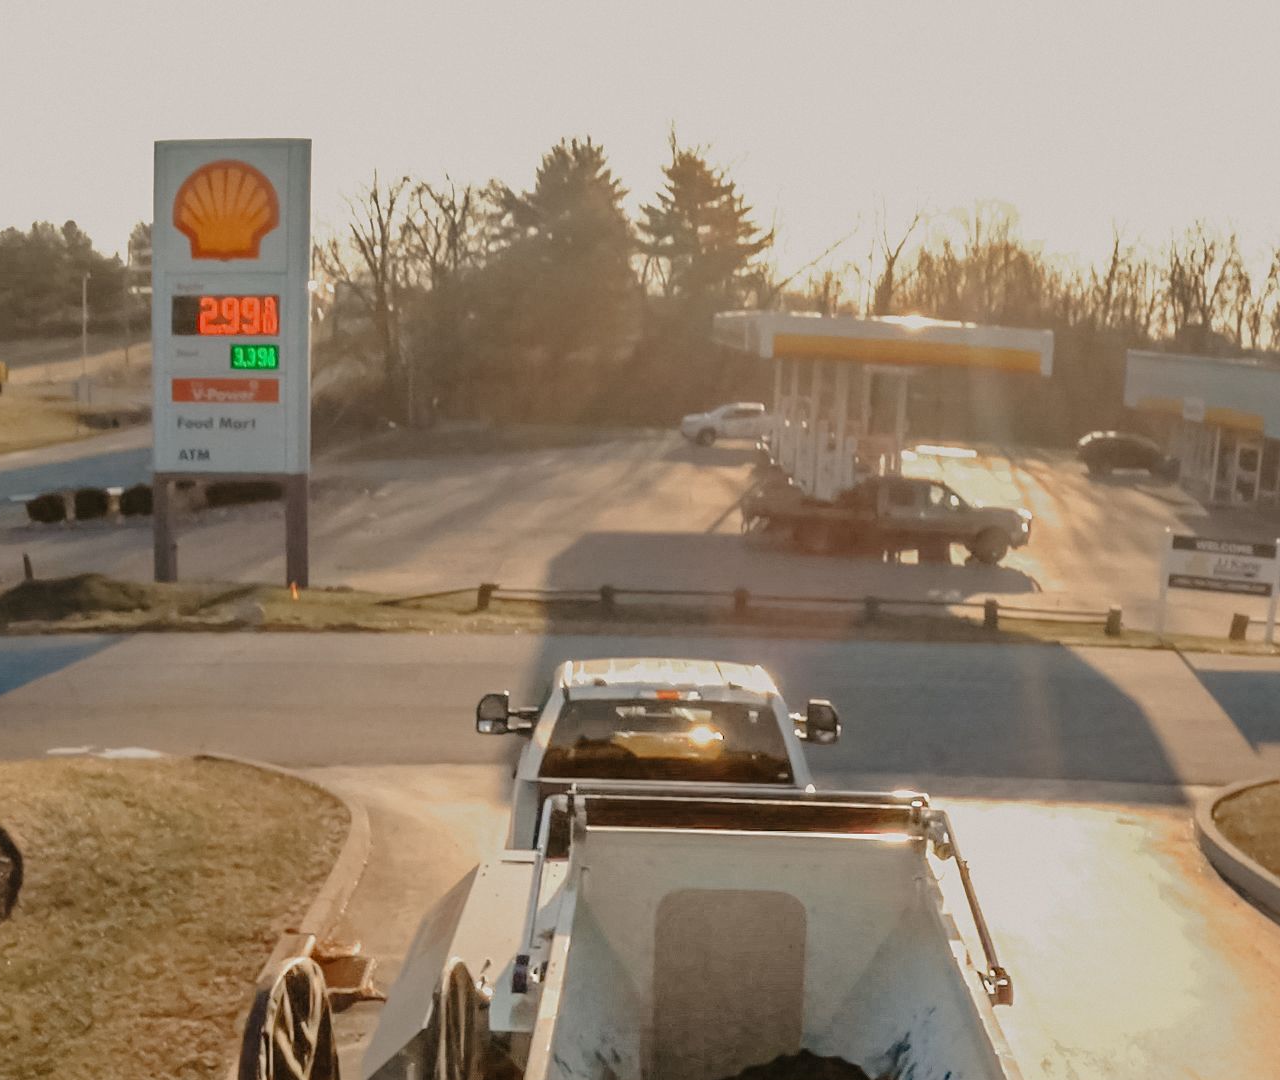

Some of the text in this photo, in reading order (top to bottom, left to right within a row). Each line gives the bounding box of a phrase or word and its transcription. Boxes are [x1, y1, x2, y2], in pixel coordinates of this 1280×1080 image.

[177, 416, 256, 429] Food Mart
[179, 448, 210, 461] ATM
